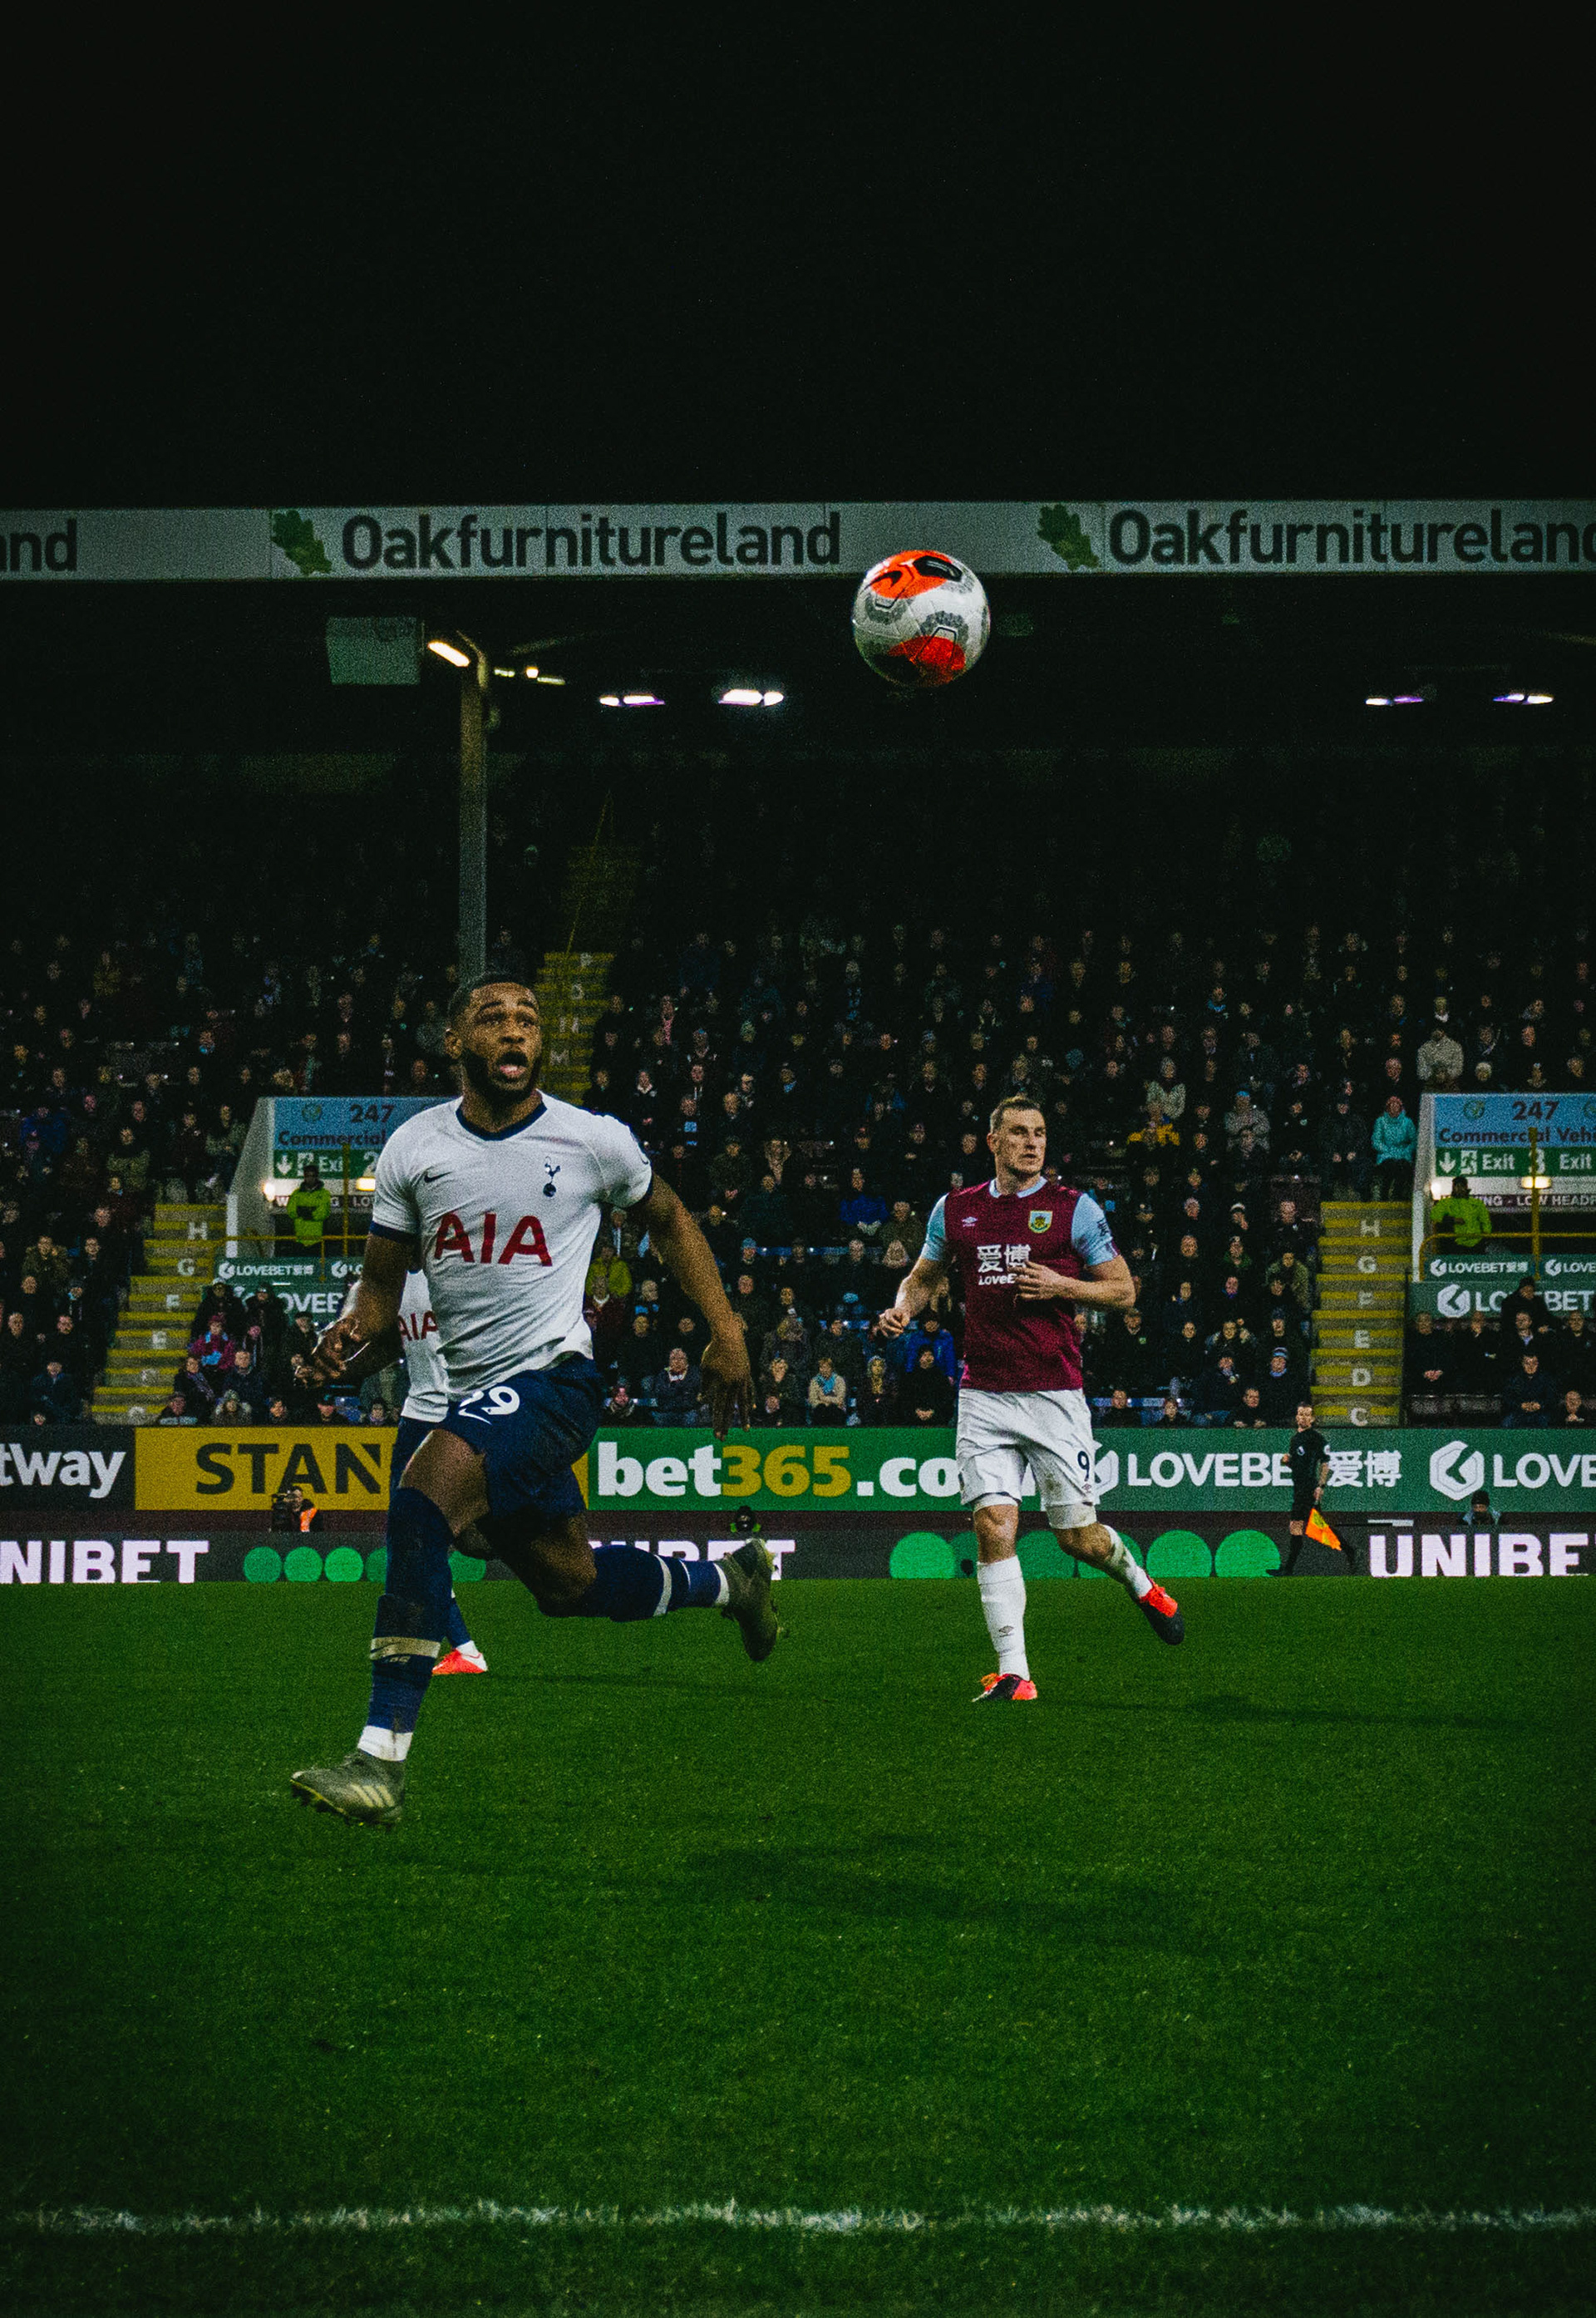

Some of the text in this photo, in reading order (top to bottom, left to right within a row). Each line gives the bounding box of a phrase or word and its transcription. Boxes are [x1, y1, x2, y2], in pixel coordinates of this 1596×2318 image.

[0, 520, 77, 572] nd
[342, 512, 840, 570] Oakfurnitureland
[350, 1104, 395, 1123] 247
[1511, 1101, 1559, 1121] 247
[278, 1130, 387, 1146] Commercial
[1439, 1127, 1550, 1143] Commercal
[318, 1156, 343, 1173] Exi
[1482, 1153, 1515, 1171] Exit
[1559, 1153, 1593, 1171] Exit
[352, 1197, 375, 1207] LO
[187, 1221, 208, 1240] H
[1361, 1220, 1381, 1237] H
[433, 1211, 553, 1267] AIA
[177, 1258, 195, 1276] G
[236, 1265, 293, 1276] LOVEBET
[1357, 1255, 1377, 1274] G
[1448, 1262, 1506, 1274] LOVEBET
[1475, 1290, 1594, 1312] LOBET
[1353, 1329, 1371, 1349] E
[1352, 1368, 1371, 1386] D
[1350, 1407, 1368, 1426] C
[195, 1443, 382, 1495] STAN
[598, 1441, 1036, 1497] bet365.co
[1077, 1450, 1090, 1482] 9
[1127, 1452, 1294, 1487] LOVEBE
[1327, 1450, 1402, 1487] 爱博
[1370, 1533, 1596, 1577] UNIBE
